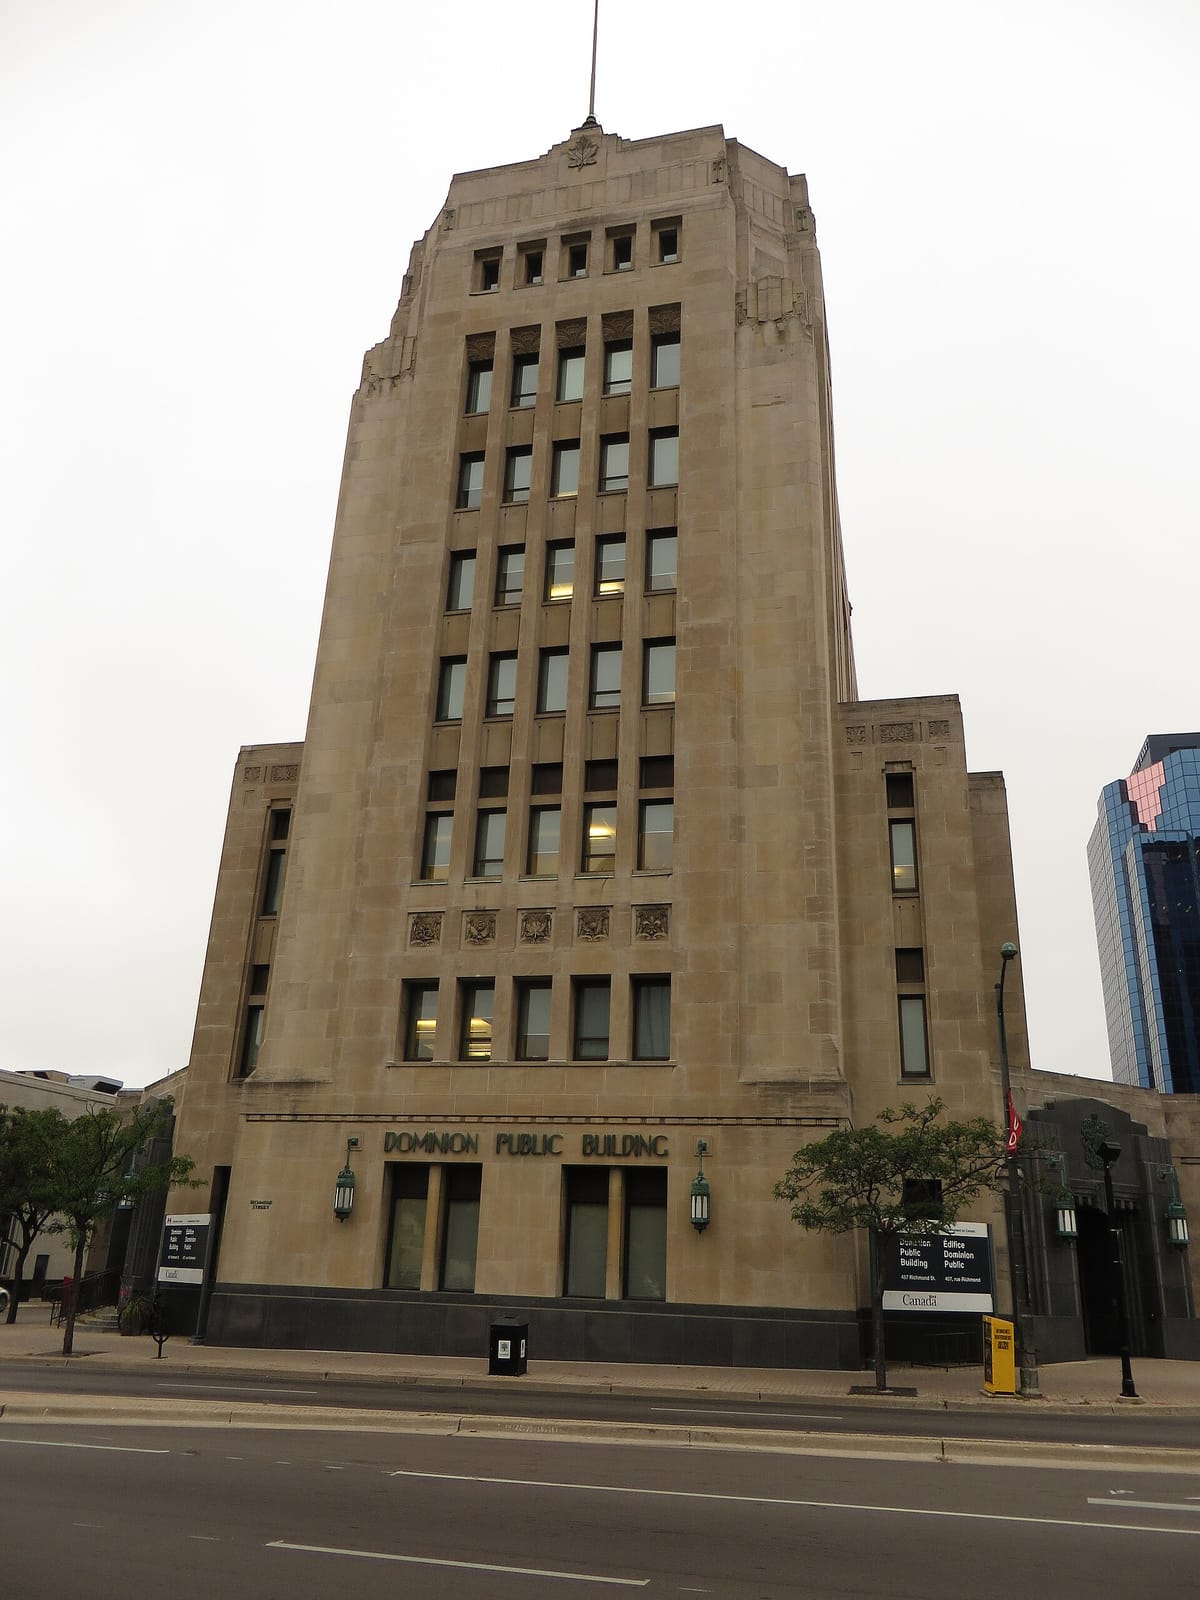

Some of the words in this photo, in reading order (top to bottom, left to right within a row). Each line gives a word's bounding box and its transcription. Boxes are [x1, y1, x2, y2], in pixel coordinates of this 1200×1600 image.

[384, 1131, 478, 1154] DOMINION
[496, 1133, 564, 1156] PUBLIC
[582, 1134, 668, 1157] BUILDING
[900, 1239, 931, 1247] Domion
[943, 1239, 966, 1249] Édifice
[900, 1248, 921, 1257] Public
[943, 1250, 975, 1259] Dominion
[900, 1258, 928, 1269] Building
[944, 1260, 965, 1269] Public
[903, 1293, 937, 1307] Canada
